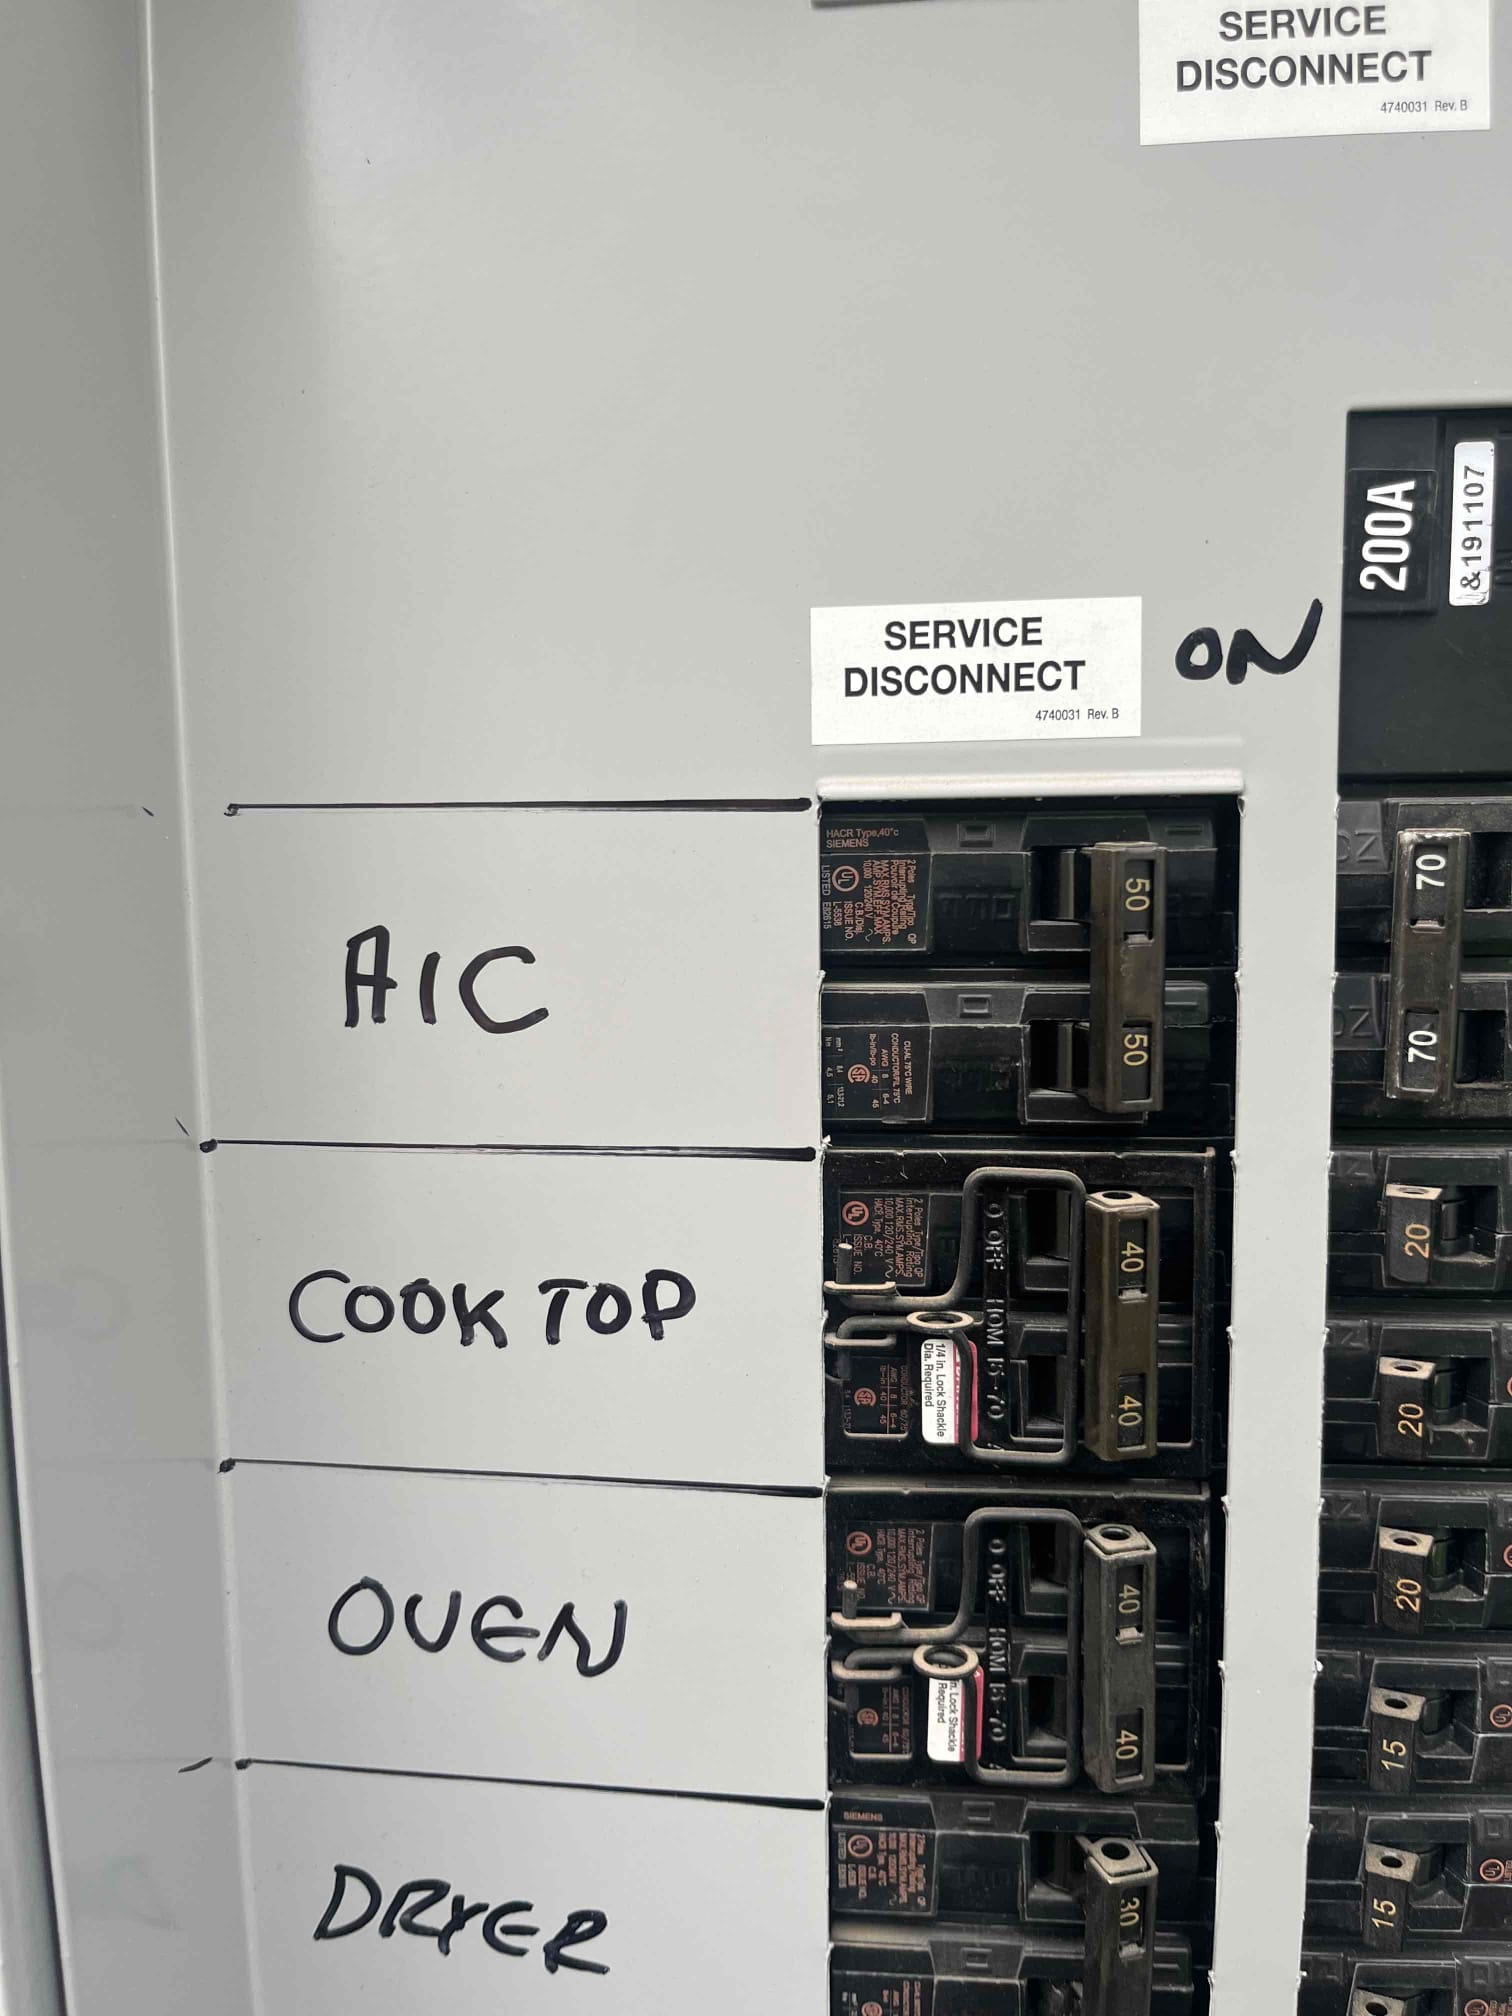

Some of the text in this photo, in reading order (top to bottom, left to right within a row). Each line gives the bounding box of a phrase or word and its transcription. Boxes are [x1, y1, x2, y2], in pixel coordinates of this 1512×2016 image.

[1218, 5, 1387, 41] SERVICE
[1176, 50, 1431, 92] DISCONNECT
[1380, 99, 1468, 113] 4740031 Rev. B
[1359, 480, 1416, 591] 200A
[1460, 465, 1485, 591] &191107
[883, 615, 1043, 651] SERVICE
[1175, 598, 1323, 684] ON
[843, 659, 1086, 698] DISCONNECT
[1035, 707, 1119, 721] 4740031 Rev. B
[826, 829, 854, 838] HACR
[826, 839, 869, 848] SIEMENS
[821, 865, 831, 896] LISTED
[1415, 854, 1446, 890] 70
[1125, 877, 1151, 911] 50
[844, 901, 853, 925] ISSUE
[1123, 1033, 1148, 1067] 50
[1408, 1030, 1438, 1063] 70
[853, 1234, 863, 1257] ISSUE
[882, 1222, 894, 1254] 120/240
[1404, 1223, 1431, 1259] 20
[1121, 1241, 1145, 1273] 40
[288, 1268, 696, 1348] COOK TOP
[921, 1343, 934, 1407] Dia. Required
[935, 1343, 947, 1438] 1/4 in. Lock Shackle
[1118, 1395, 1142, 1426] 40
[1397, 1403, 1424, 1438] 20
[1118, 1584, 1141, 1614] 40
[1394, 1578, 1422, 1613] 20
[327, 1576, 627, 1677] OVEN
[936, 1682, 948, 1724] Required
[949, 1693, 958, 1714] Lock
[1115, 1730, 1139, 1760] 40
[1381, 1738, 1406, 1771] 15
[843, 1811, 883, 1822] SIEMENS
[313, 1864, 610, 1974] DRYER
[1120, 1897, 1140, 1927] 30
[1371, 1898, 1396, 1929] 15
